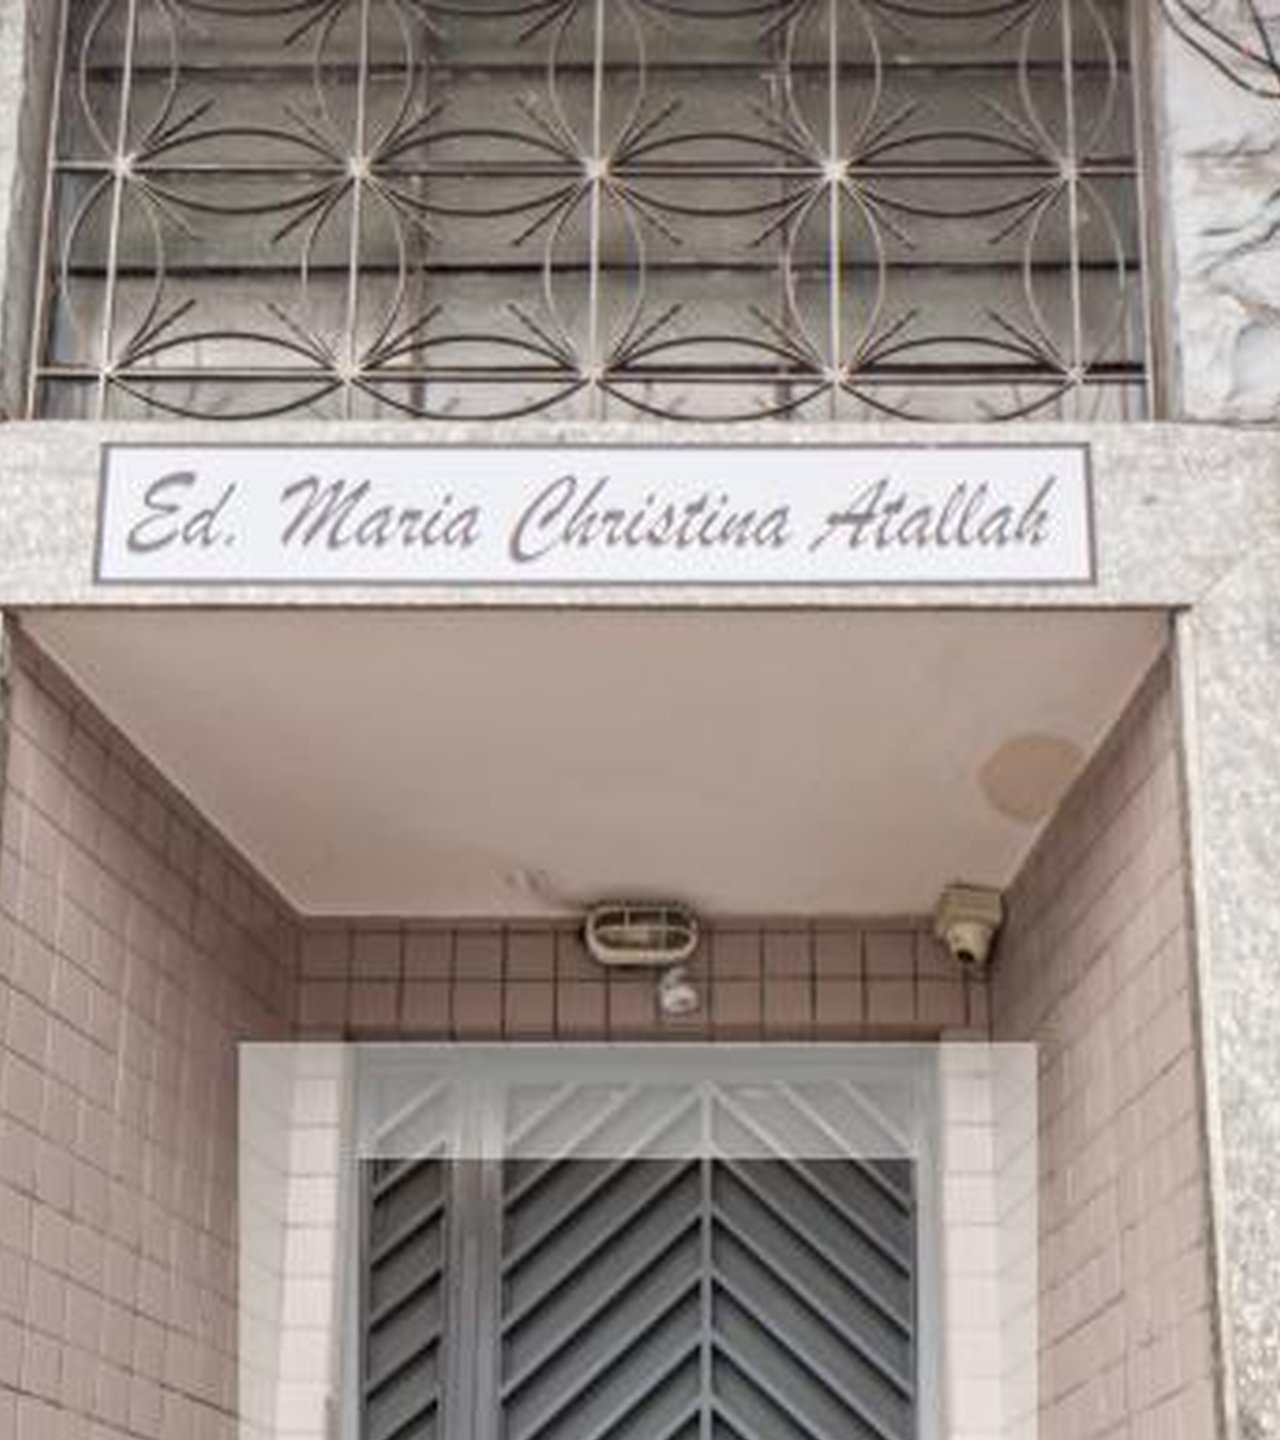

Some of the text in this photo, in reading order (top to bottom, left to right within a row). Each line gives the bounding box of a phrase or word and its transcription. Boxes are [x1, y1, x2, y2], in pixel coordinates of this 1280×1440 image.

[125, 471, 1058, 563] Ed. Maria Christina Atallah
